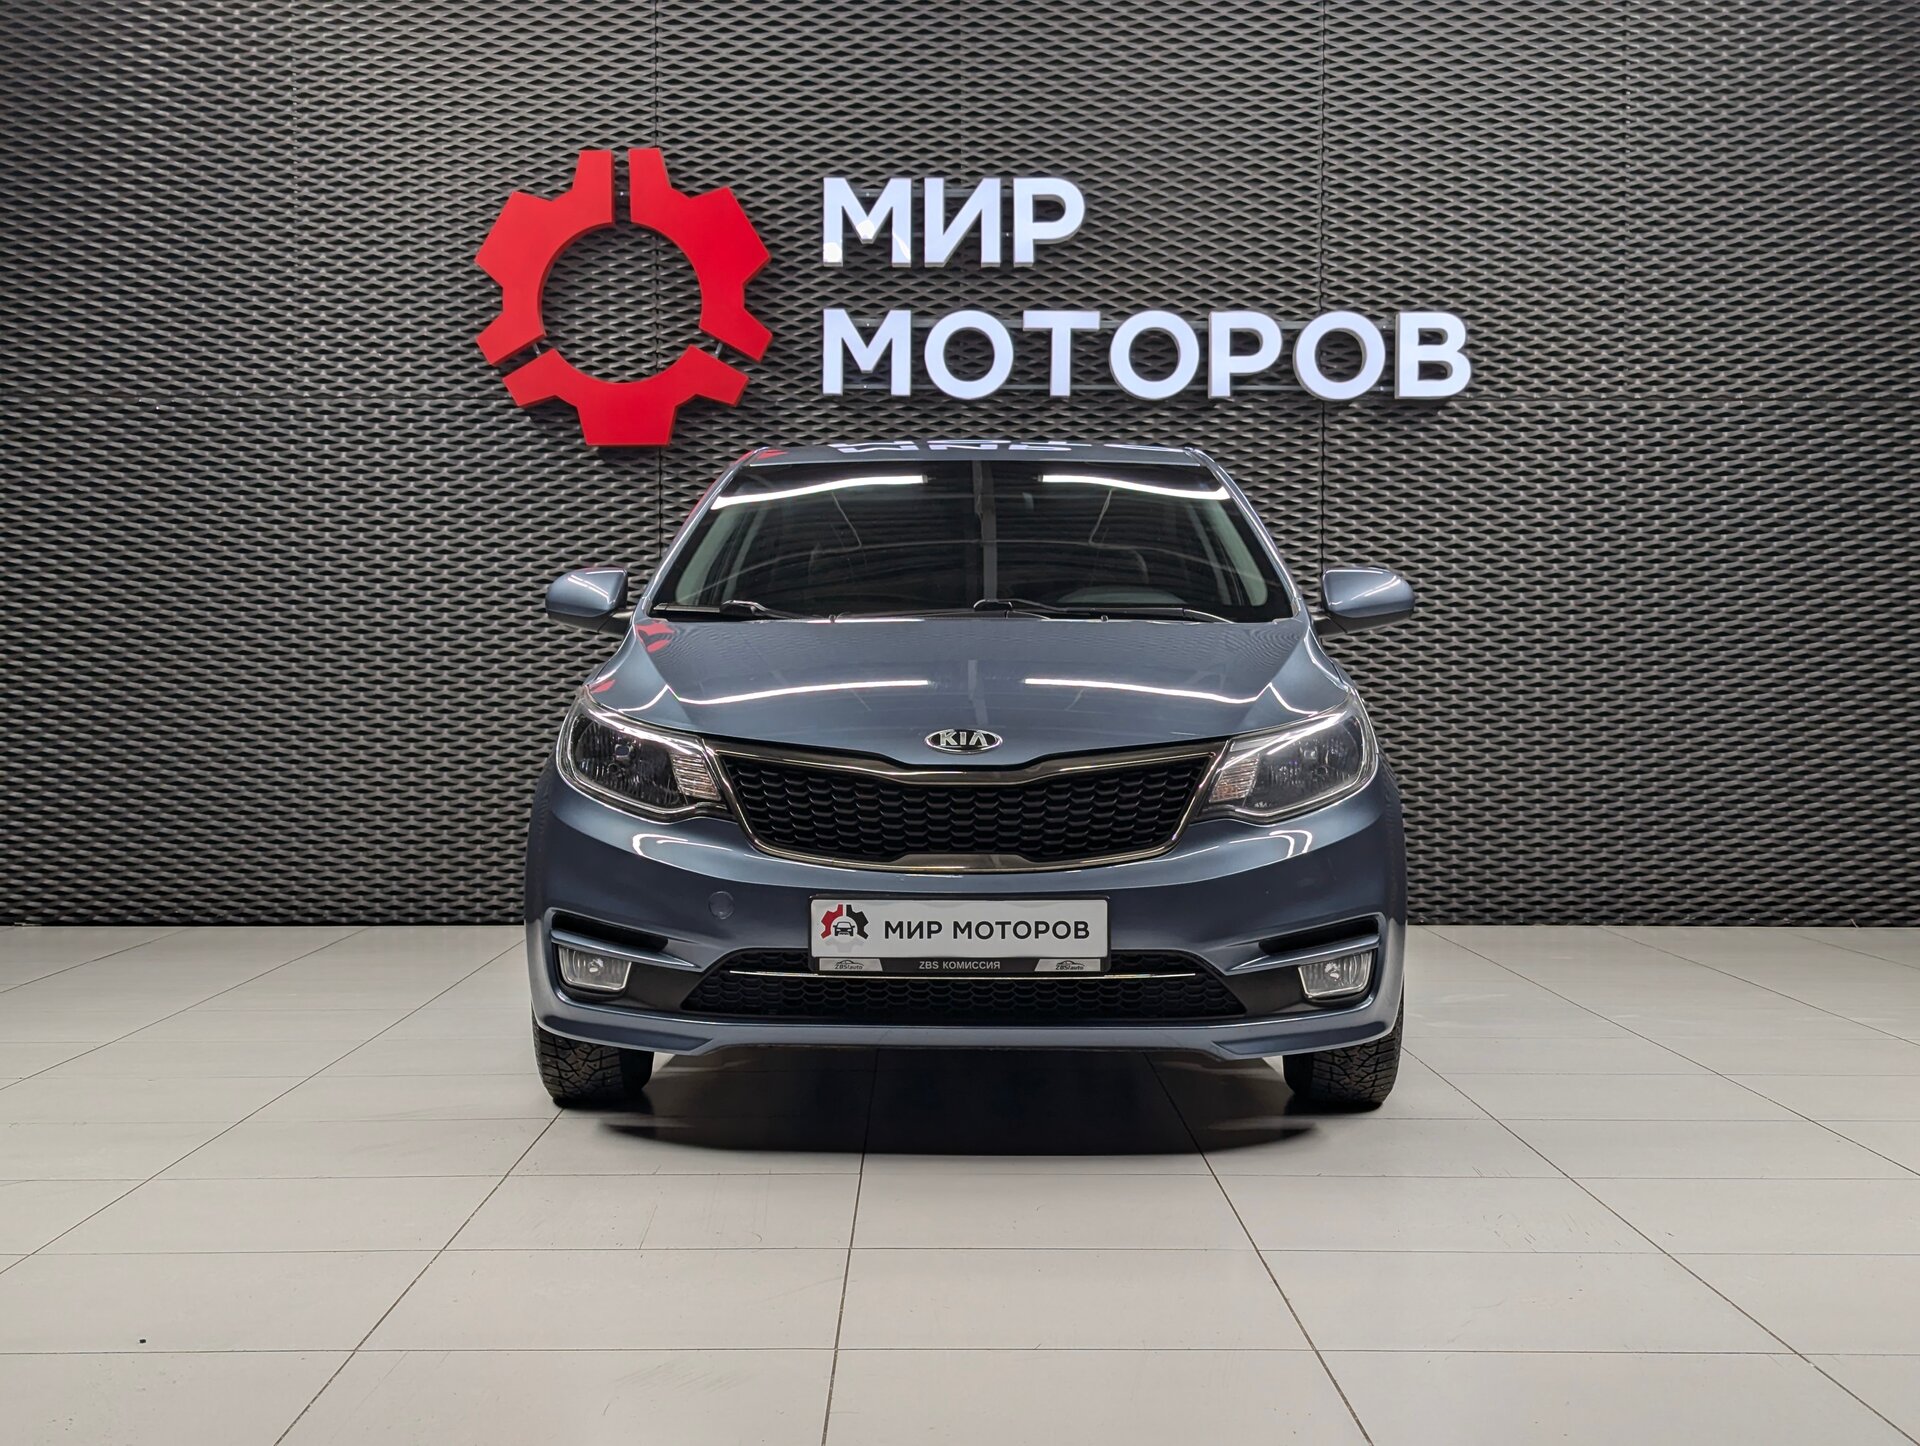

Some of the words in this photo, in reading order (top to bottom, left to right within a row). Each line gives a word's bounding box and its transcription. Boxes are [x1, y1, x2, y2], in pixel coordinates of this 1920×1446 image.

[823, 177, 1086, 267] МИР
[822, 309, 1472, 401] МОТОРОВ
[939, 730, 988, 747] KIA
[884, 920, 943, 940] МИР
[953, 920, 1090, 940] МОТОРОВ
[919, 961, 938, 970] ZBS
[942, 961, 1001, 970] КОМИССИЯ
